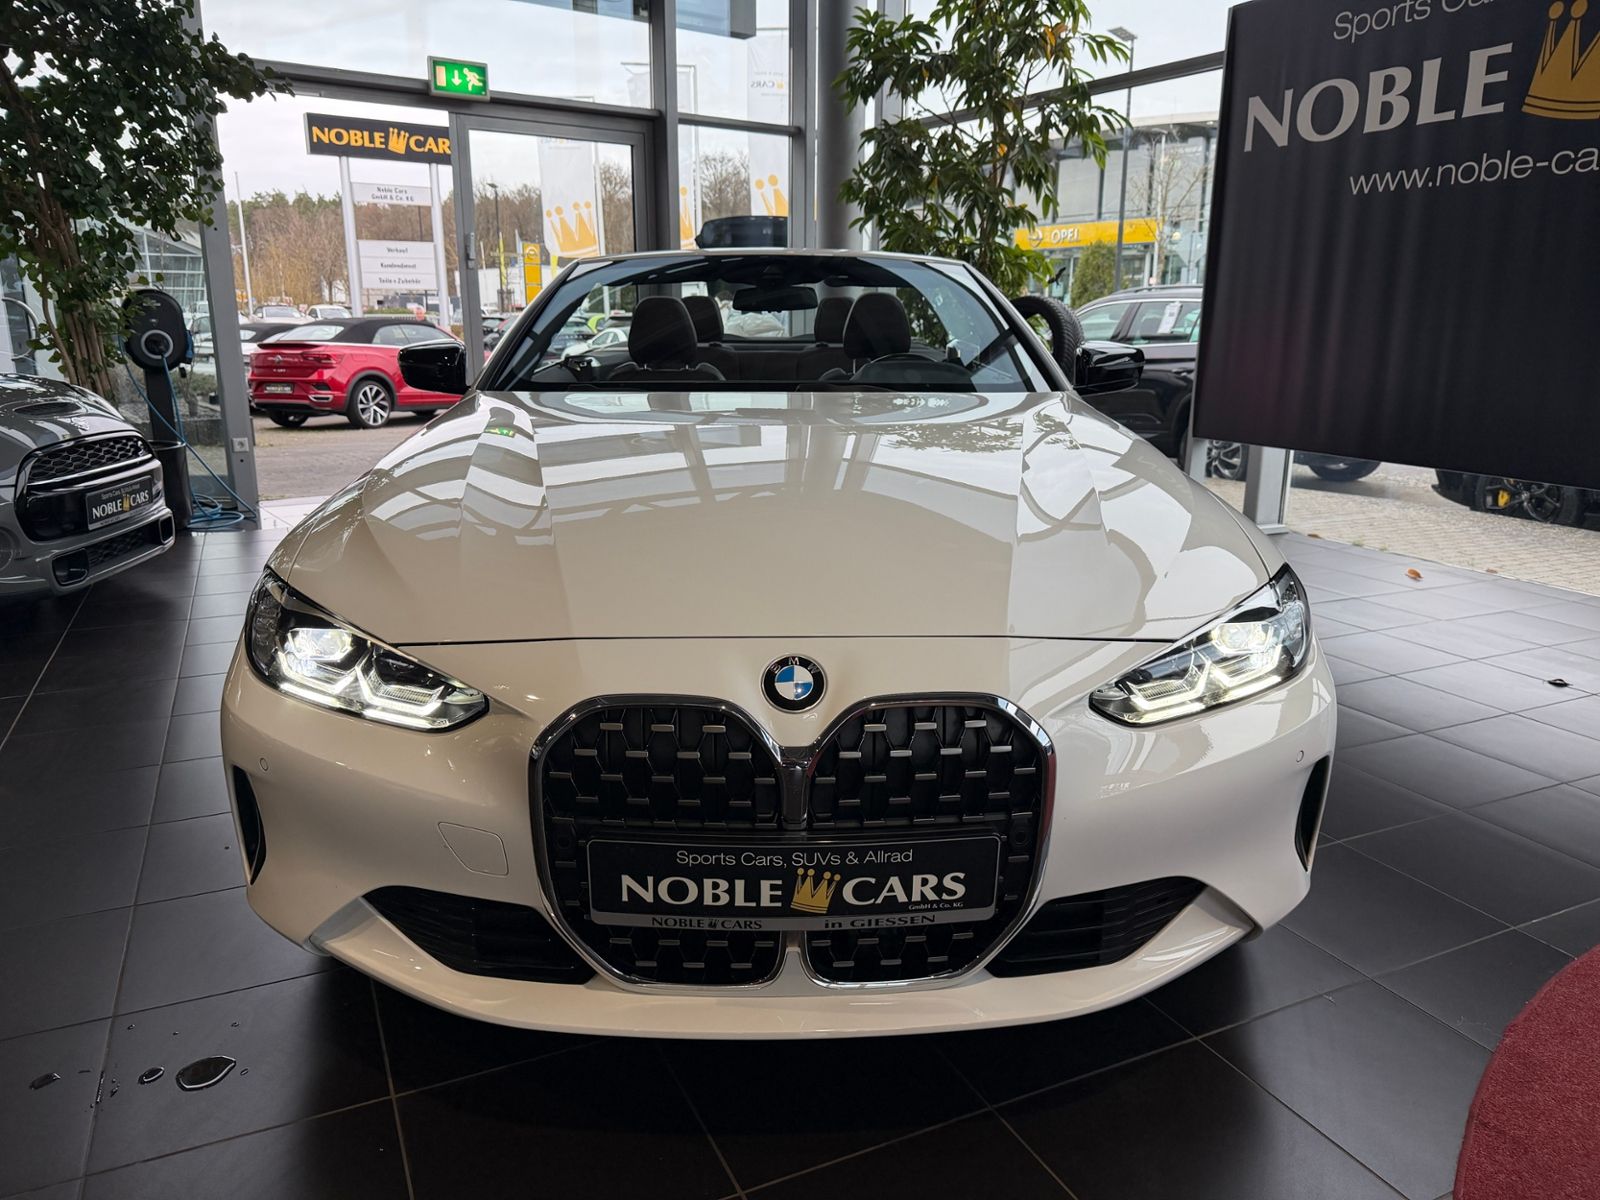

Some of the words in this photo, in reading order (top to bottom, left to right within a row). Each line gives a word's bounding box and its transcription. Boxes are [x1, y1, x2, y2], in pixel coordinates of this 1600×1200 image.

[1333, 0, 1431, 43] Sports
[1244, 42, 1513, 153] NOBLE
[312, 126, 386, 149] NOBLE
[1051, 228, 1079, 244] OPEL
[92, 499, 123, 519] NOBLE
[130, 489, 149, 507] CARS
[770, 656, 821, 674] BMW
[676, 850, 736, 867] Sports
[740, 852, 787, 869] Cars,
[791, 852, 841, 866] SUVs
[845, 850, 860, 865] &
[864, 849, 913, 864] Allrad
[621, 874, 782, 907] NOBLE
[842, 871, 966, 906] CARS
[651, 916, 705, 929] NOBLE
[720, 919, 763, 930] CARS
[824, 919, 843, 929] in
[849, 914, 936, 928] GIESSEN
